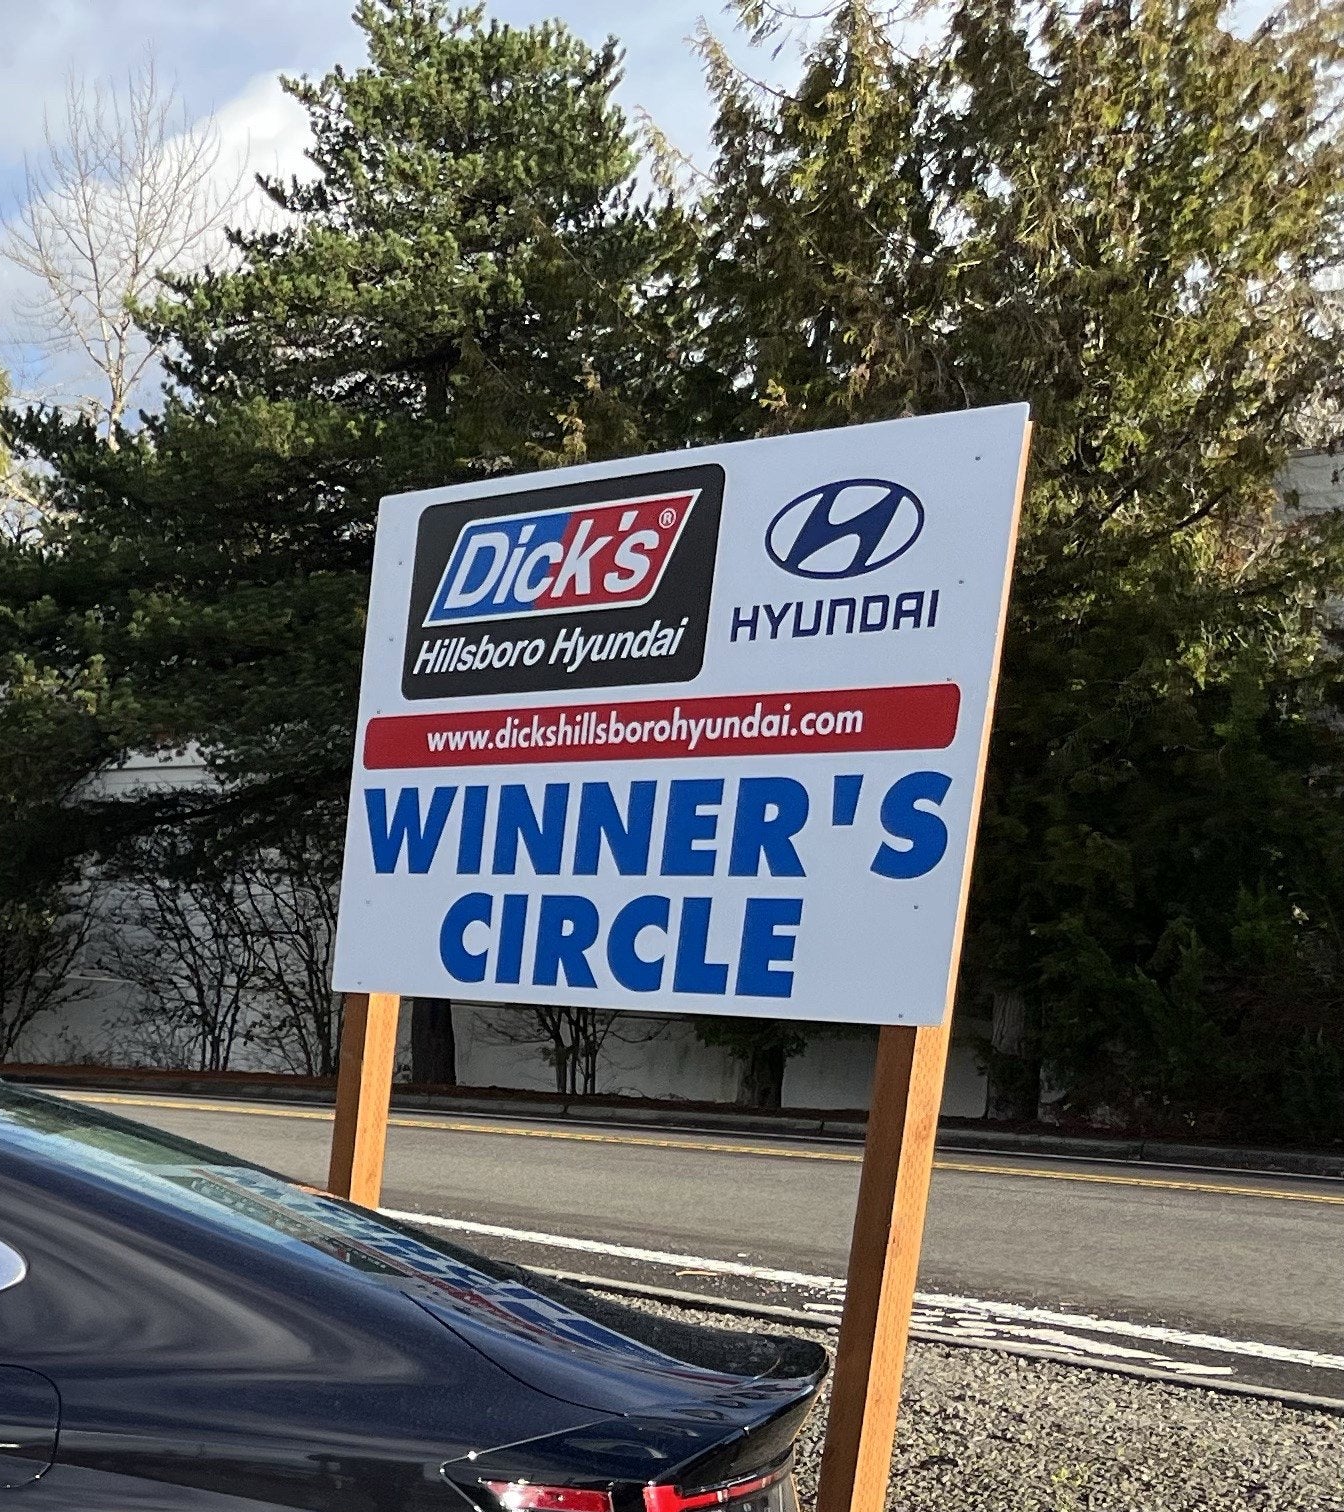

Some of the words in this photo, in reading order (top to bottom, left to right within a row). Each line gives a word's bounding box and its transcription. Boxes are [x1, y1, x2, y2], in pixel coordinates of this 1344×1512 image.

[412, 635, 545, 675] Hillsboro
[548, 616, 690, 673] Hyundai
[729, 589, 940, 643] HYUNDAI
[425, 702, 864, 751] www.dickshillsborohyundai.com
[363, 770, 954, 880] WINNER'S
[439, 892, 804, 998] CIRCLE
